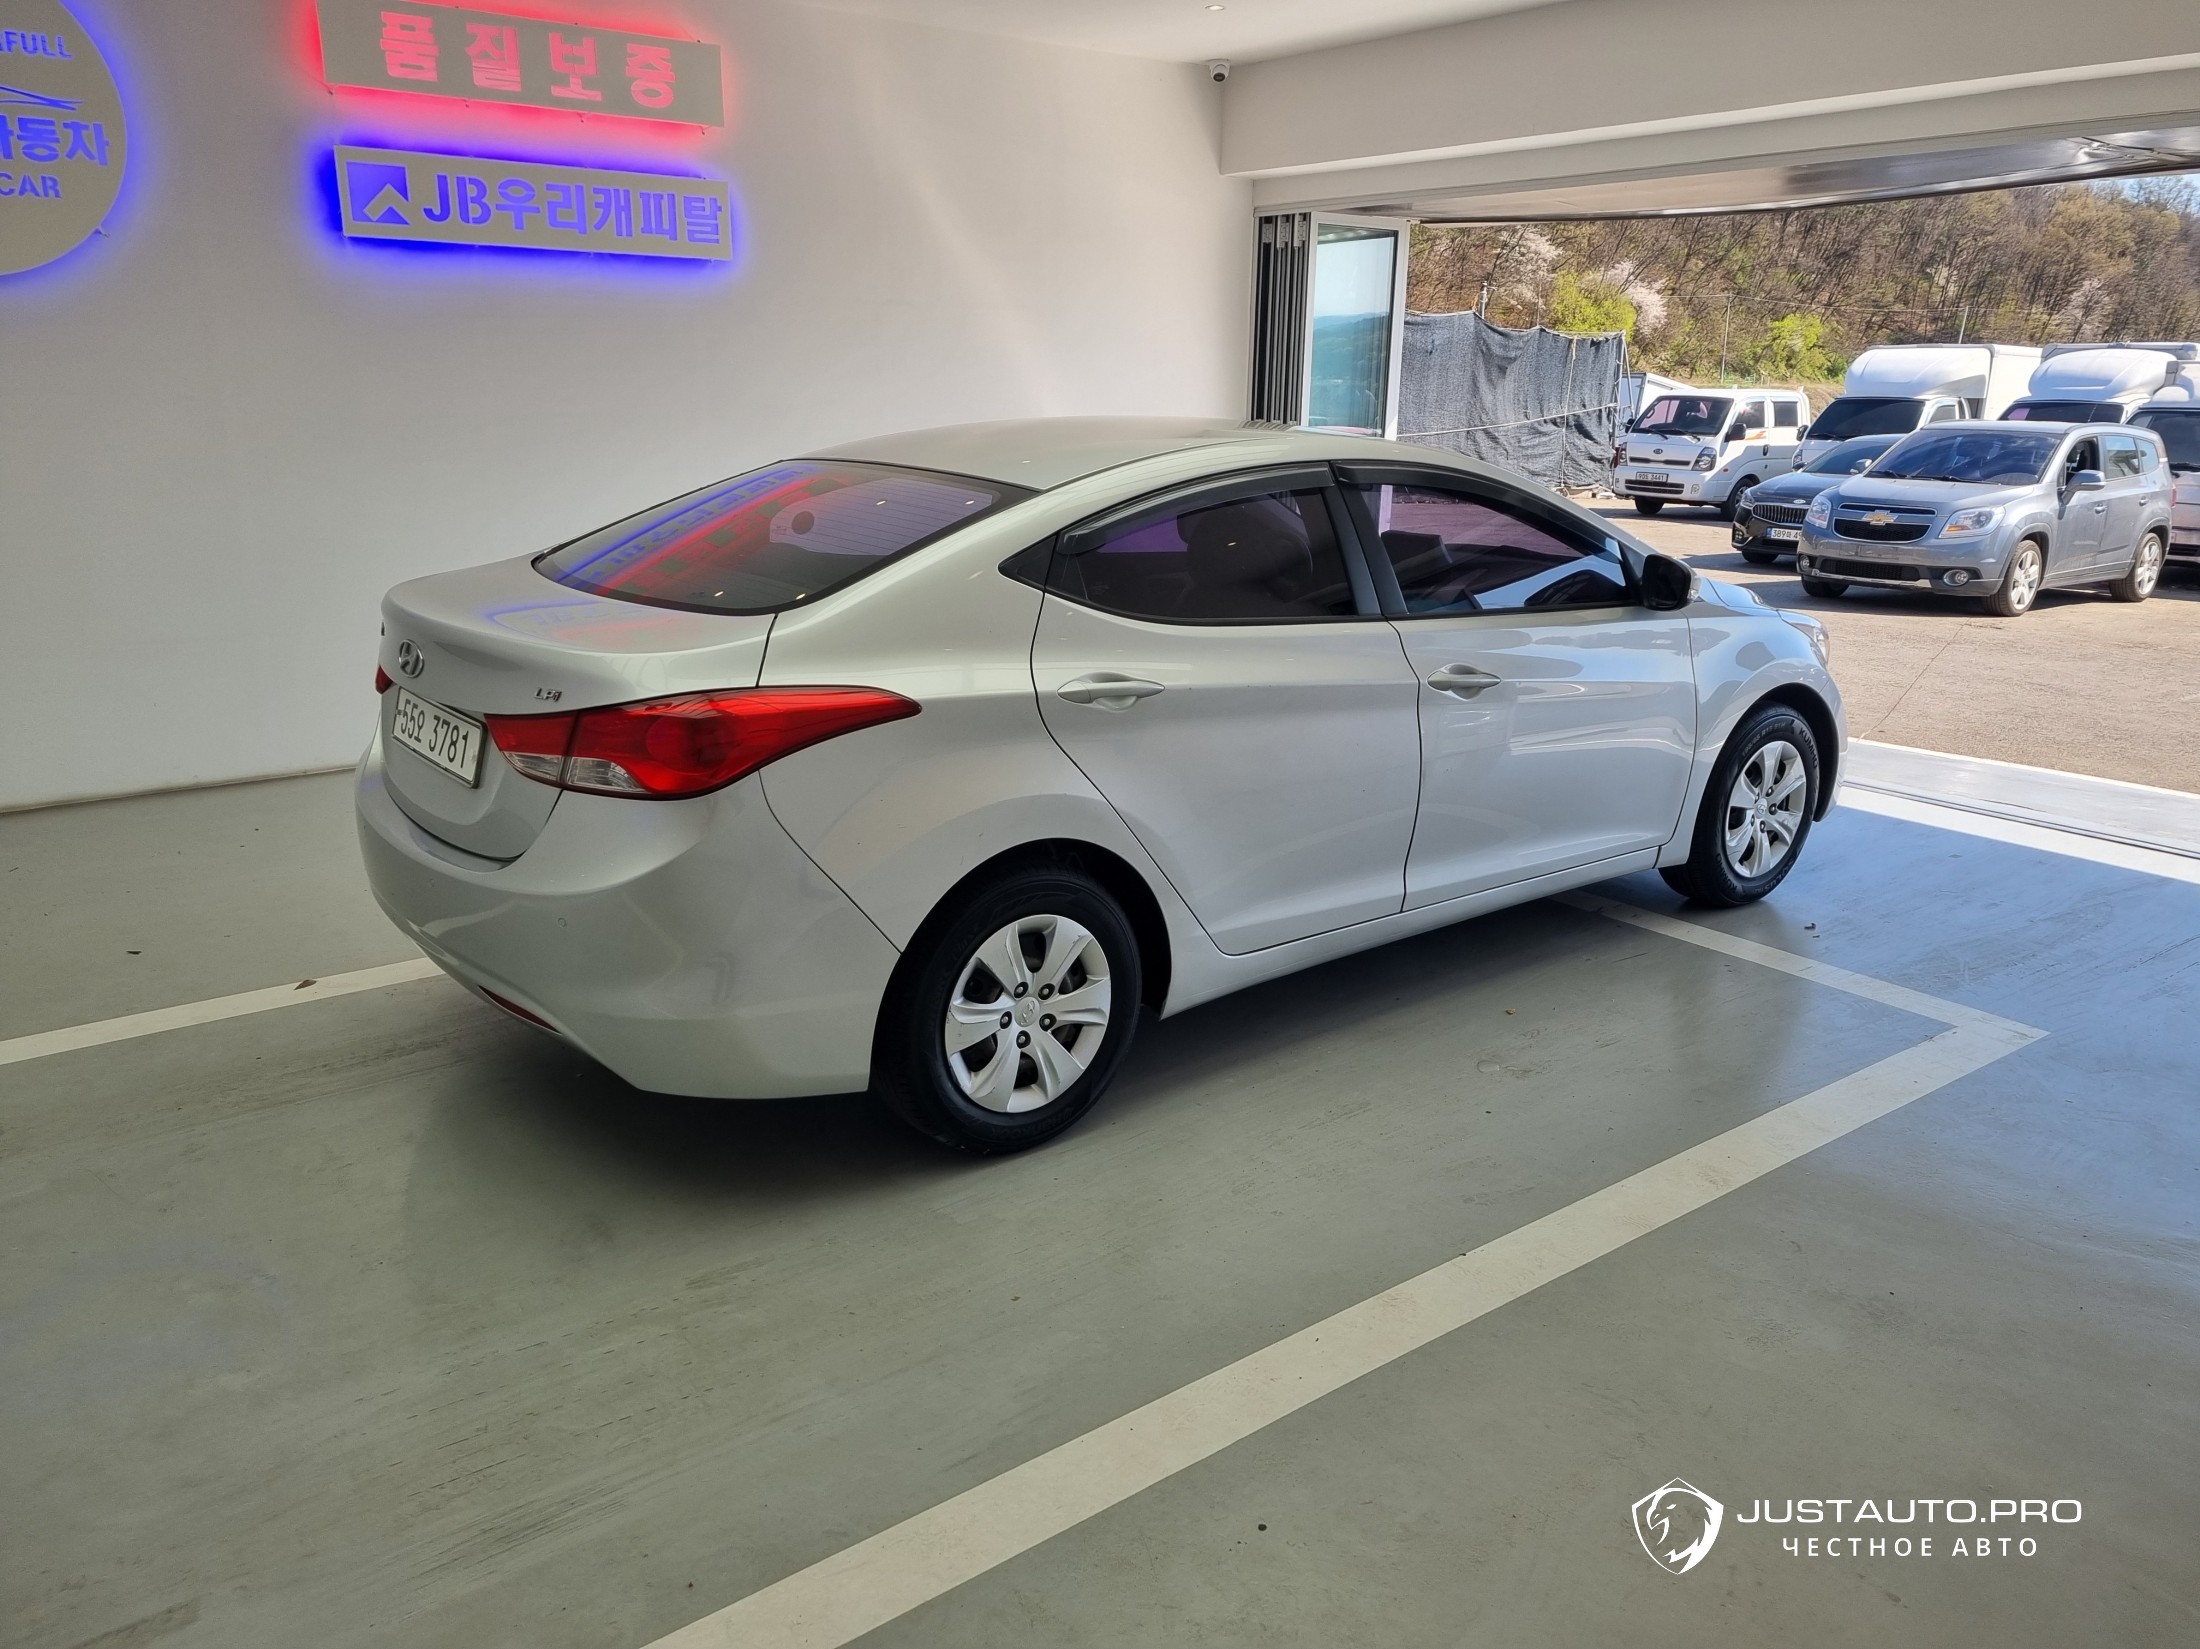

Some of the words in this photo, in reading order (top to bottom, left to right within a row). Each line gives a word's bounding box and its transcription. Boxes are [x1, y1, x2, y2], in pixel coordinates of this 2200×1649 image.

[0, 30, 73, 59] FULL
[381, 11, 676, 109] 품질보증
[0, 172, 62, 199] CAR
[423, 173, 723, 244] JB우리캐피탈
[428, 714, 469, 769] 3781
[1798, 726, 1818, 769] KUMHO
